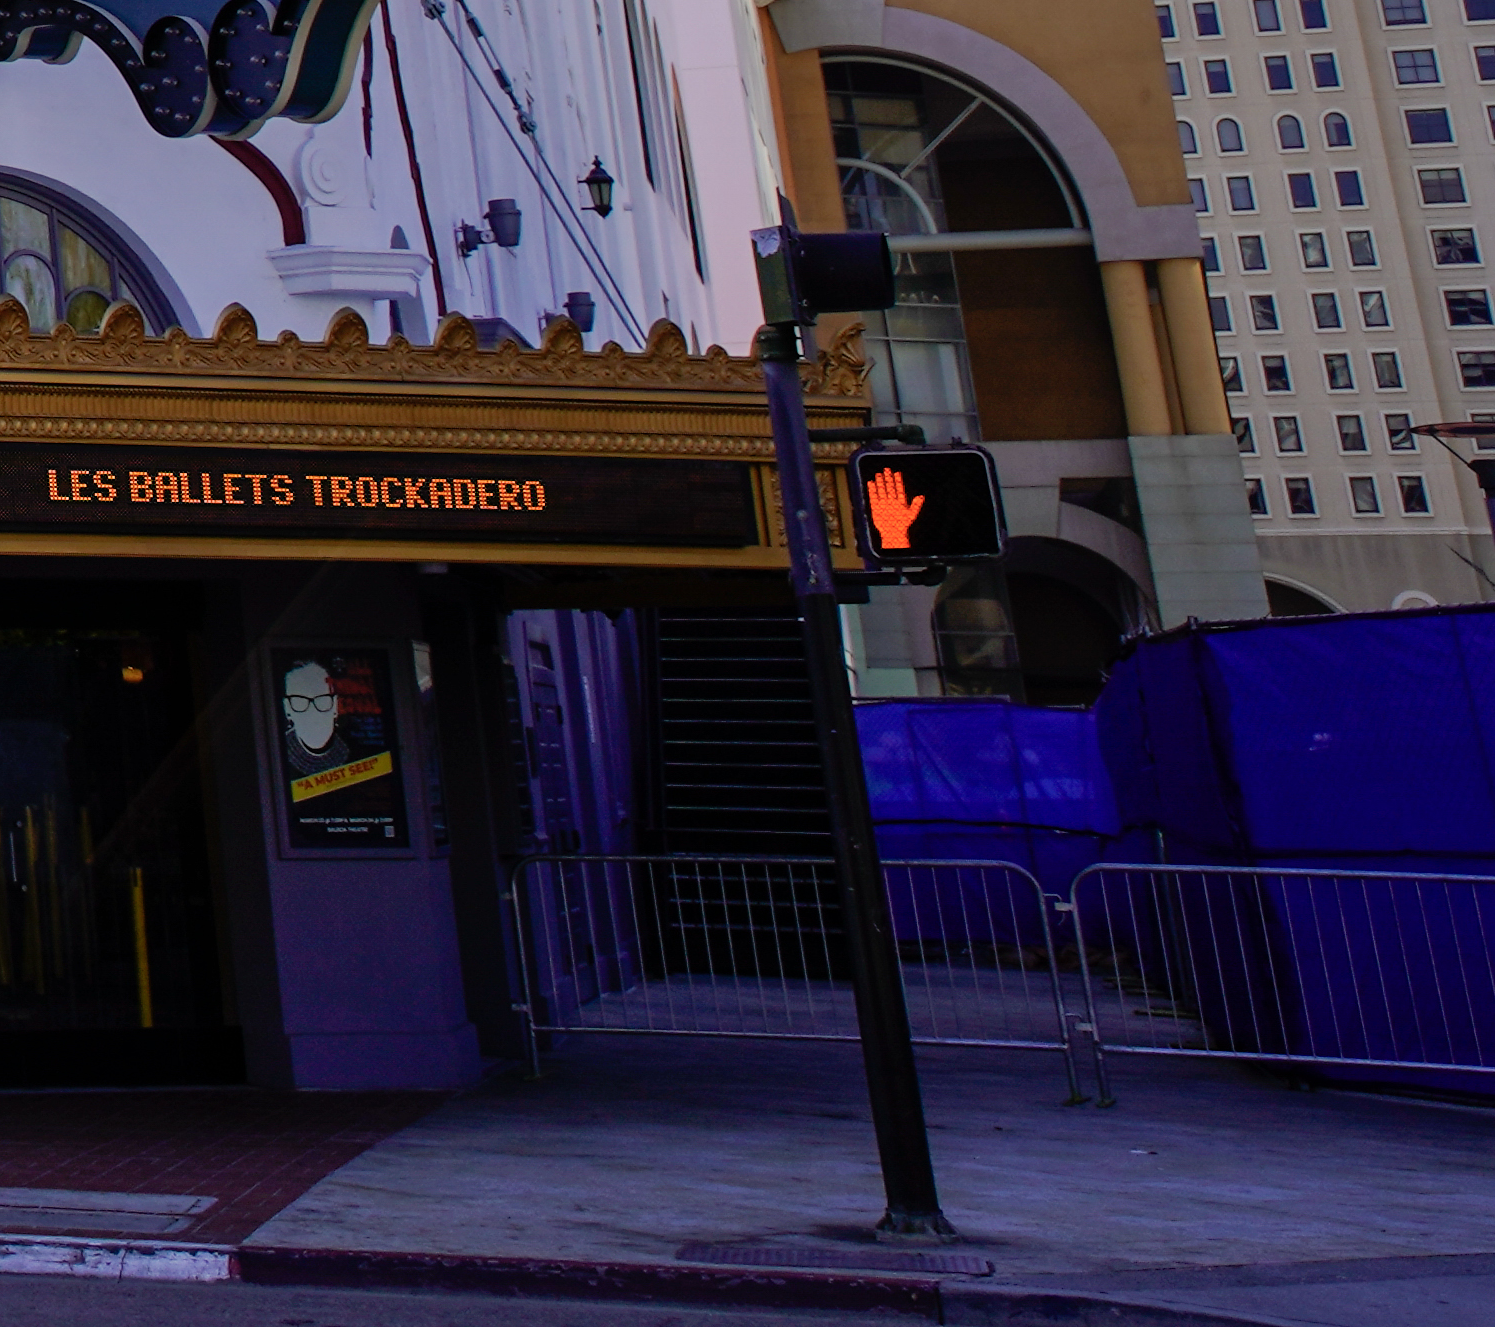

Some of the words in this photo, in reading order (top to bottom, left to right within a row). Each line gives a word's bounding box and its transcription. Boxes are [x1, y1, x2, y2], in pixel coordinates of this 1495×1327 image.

[48, 469, 117, 502] LES
[129, 471, 295, 506] BALLETS
[306, 474, 547, 511] TROCKADERO
[315, 767, 346, 787] MUST
[348, 757, 379, 776] SEE!"
